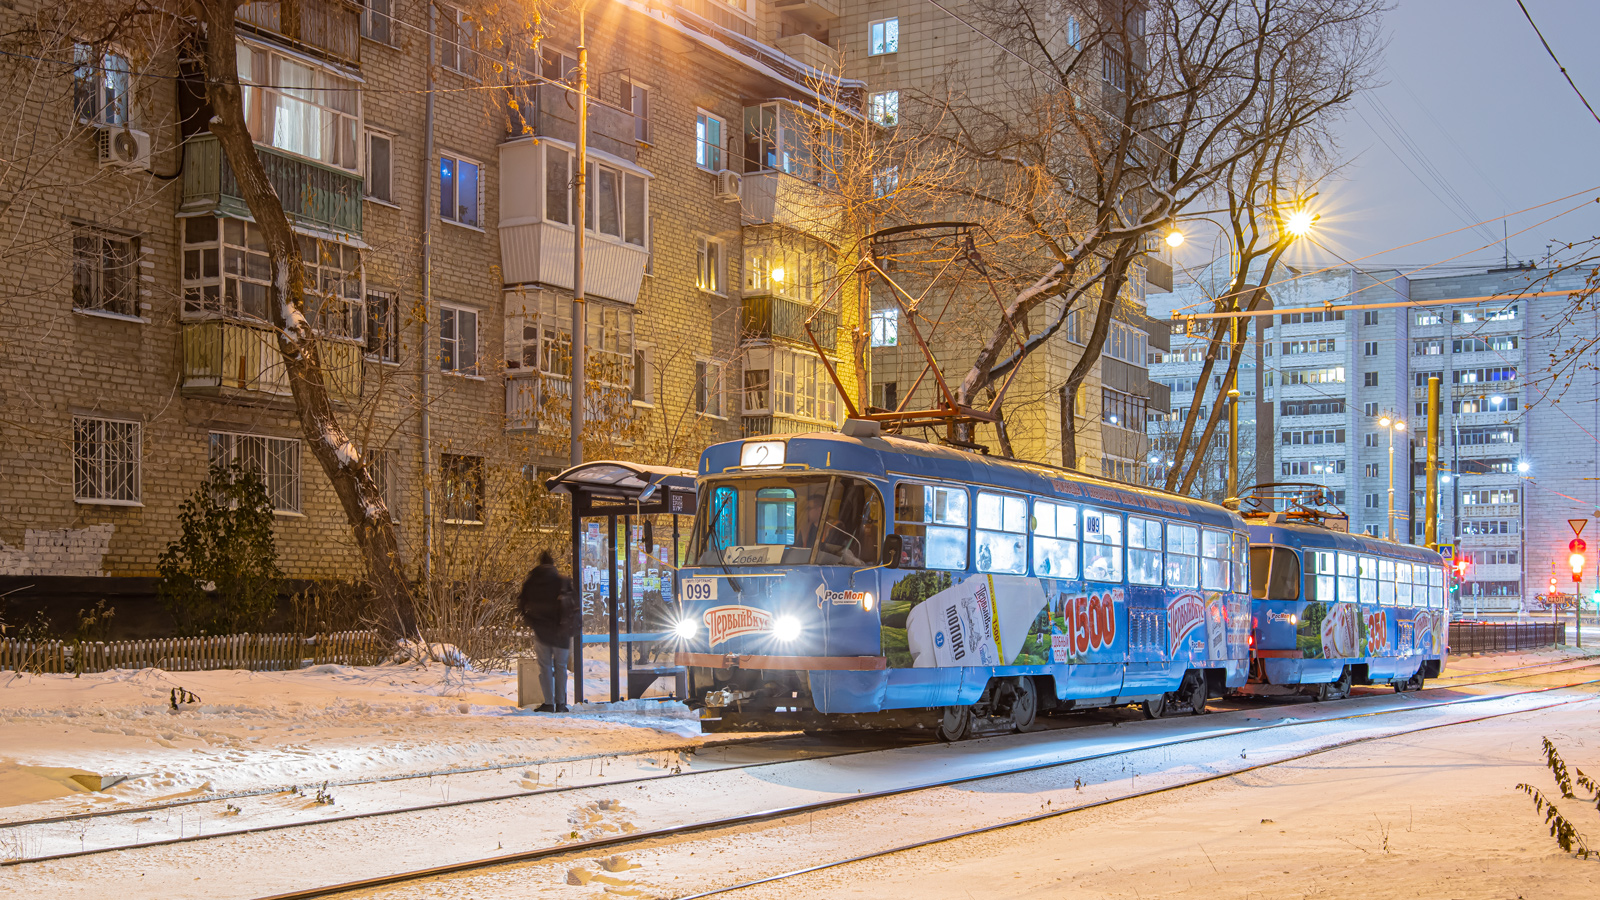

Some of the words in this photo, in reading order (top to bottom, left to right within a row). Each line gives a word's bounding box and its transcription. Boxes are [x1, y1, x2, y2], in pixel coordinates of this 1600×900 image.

[756, 445, 769, 467] 2
[1087, 517, 1100, 533] 099
[740, 551, 763, 564] обед
[686, 583, 711, 600] 099
[825, 591, 863, 600] РосМол
[1065, 593, 1115, 656] 1500
[1368, 610, 1387, 654] 350
